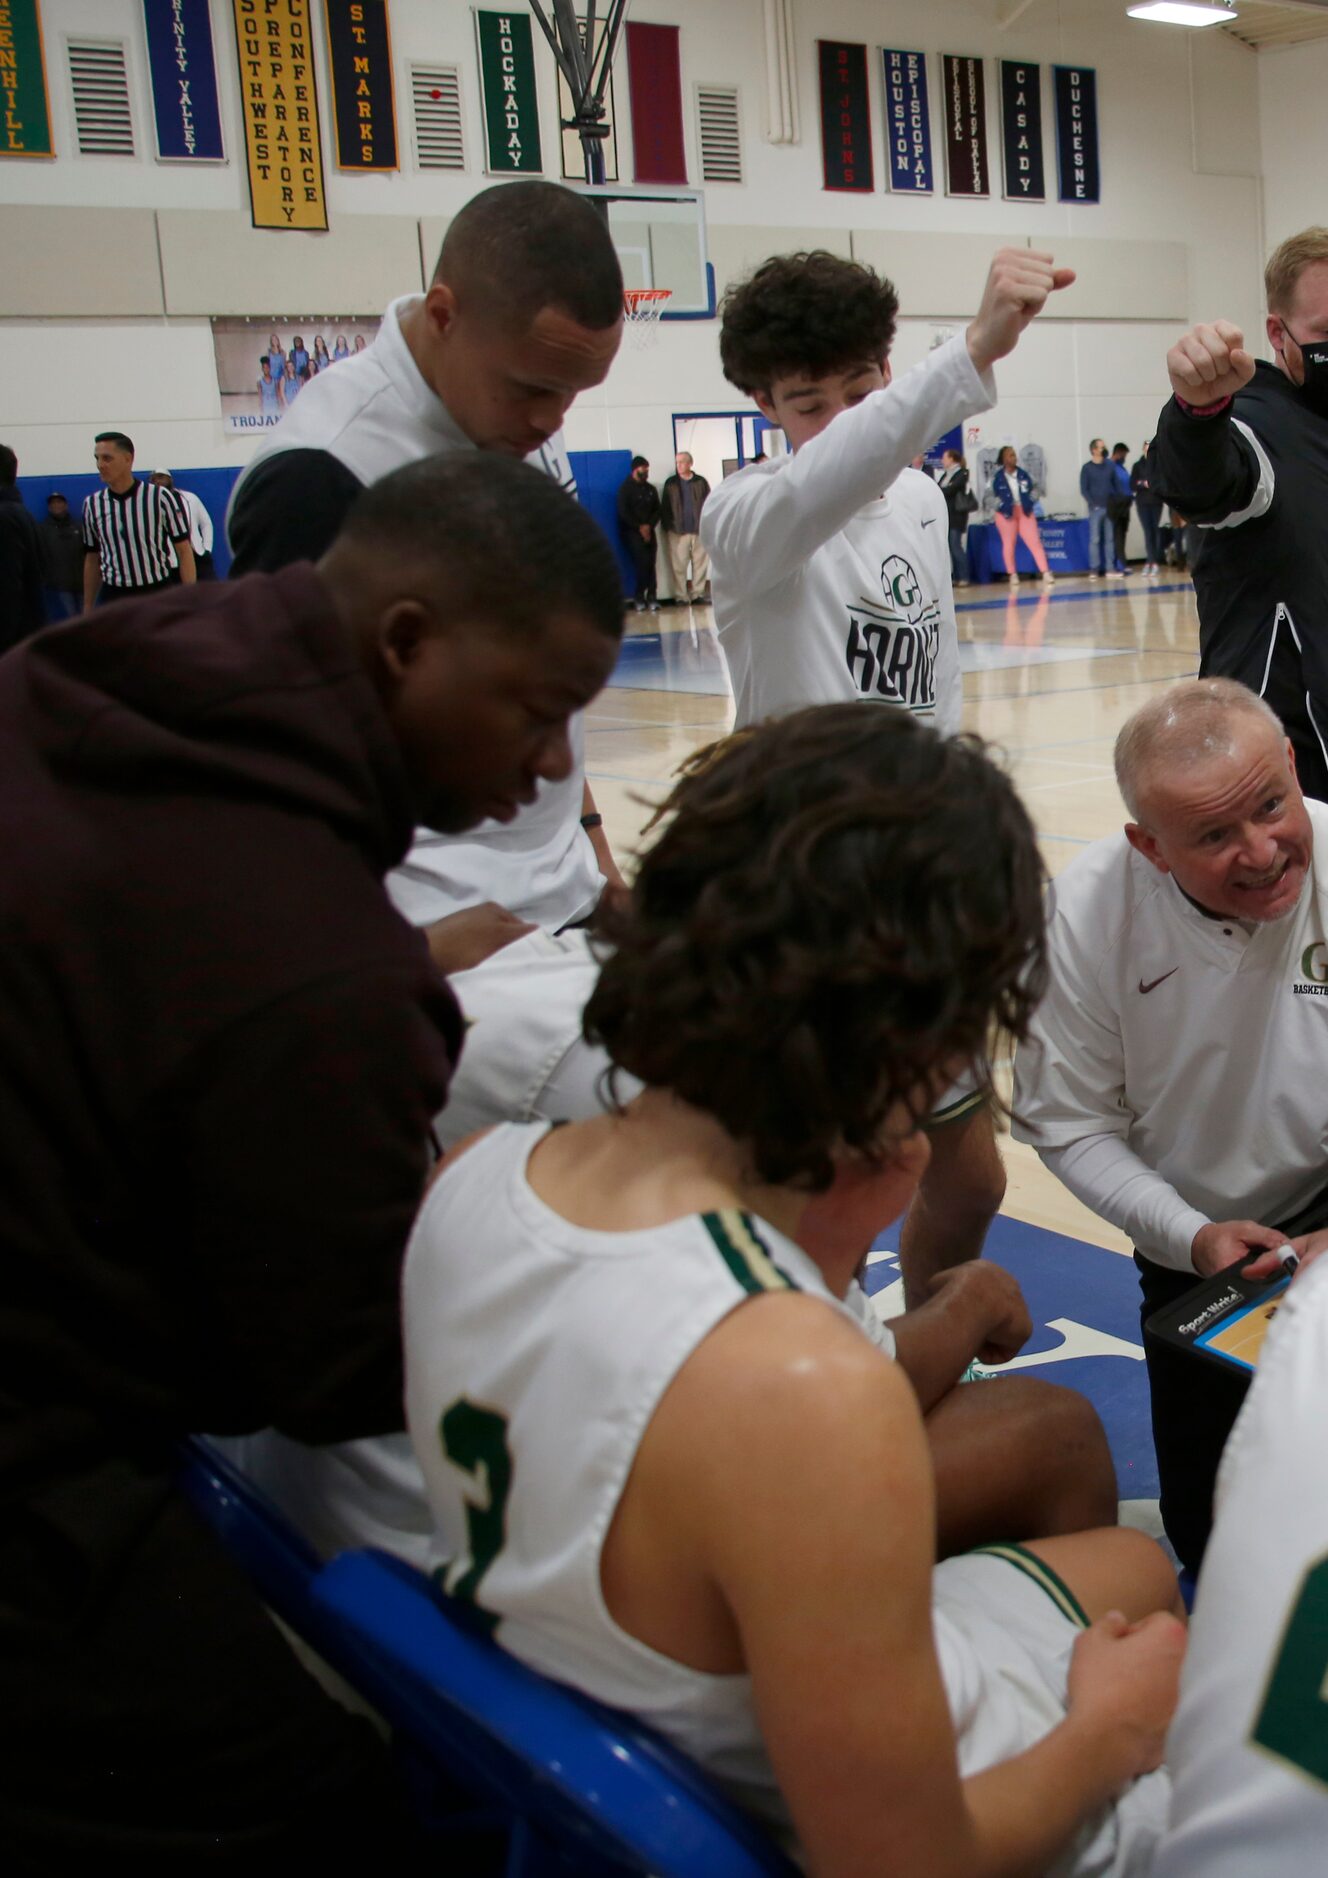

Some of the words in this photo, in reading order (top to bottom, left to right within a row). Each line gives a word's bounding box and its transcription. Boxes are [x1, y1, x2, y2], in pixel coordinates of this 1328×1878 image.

[178, 80, 196, 155] VALLEY
[241, 0, 271, 180] SOUTHWEST
[264, 0, 295, 223] PREPARATORY
[288, 0, 318, 202] CONFERENCE
[353, 57, 373, 162] MARKS
[499, 18, 521, 167] HOCKADAY
[890, 53, 908, 170] HOUSTON
[908, 54, 926, 188] EPISCOPAL
[1015, 70, 1031, 192] CASADY
[1070, 71, 1086, 198] DUCHESNE
[892, 573, 915, 607] G
[1178, 1310, 1211, 1335] Sport
